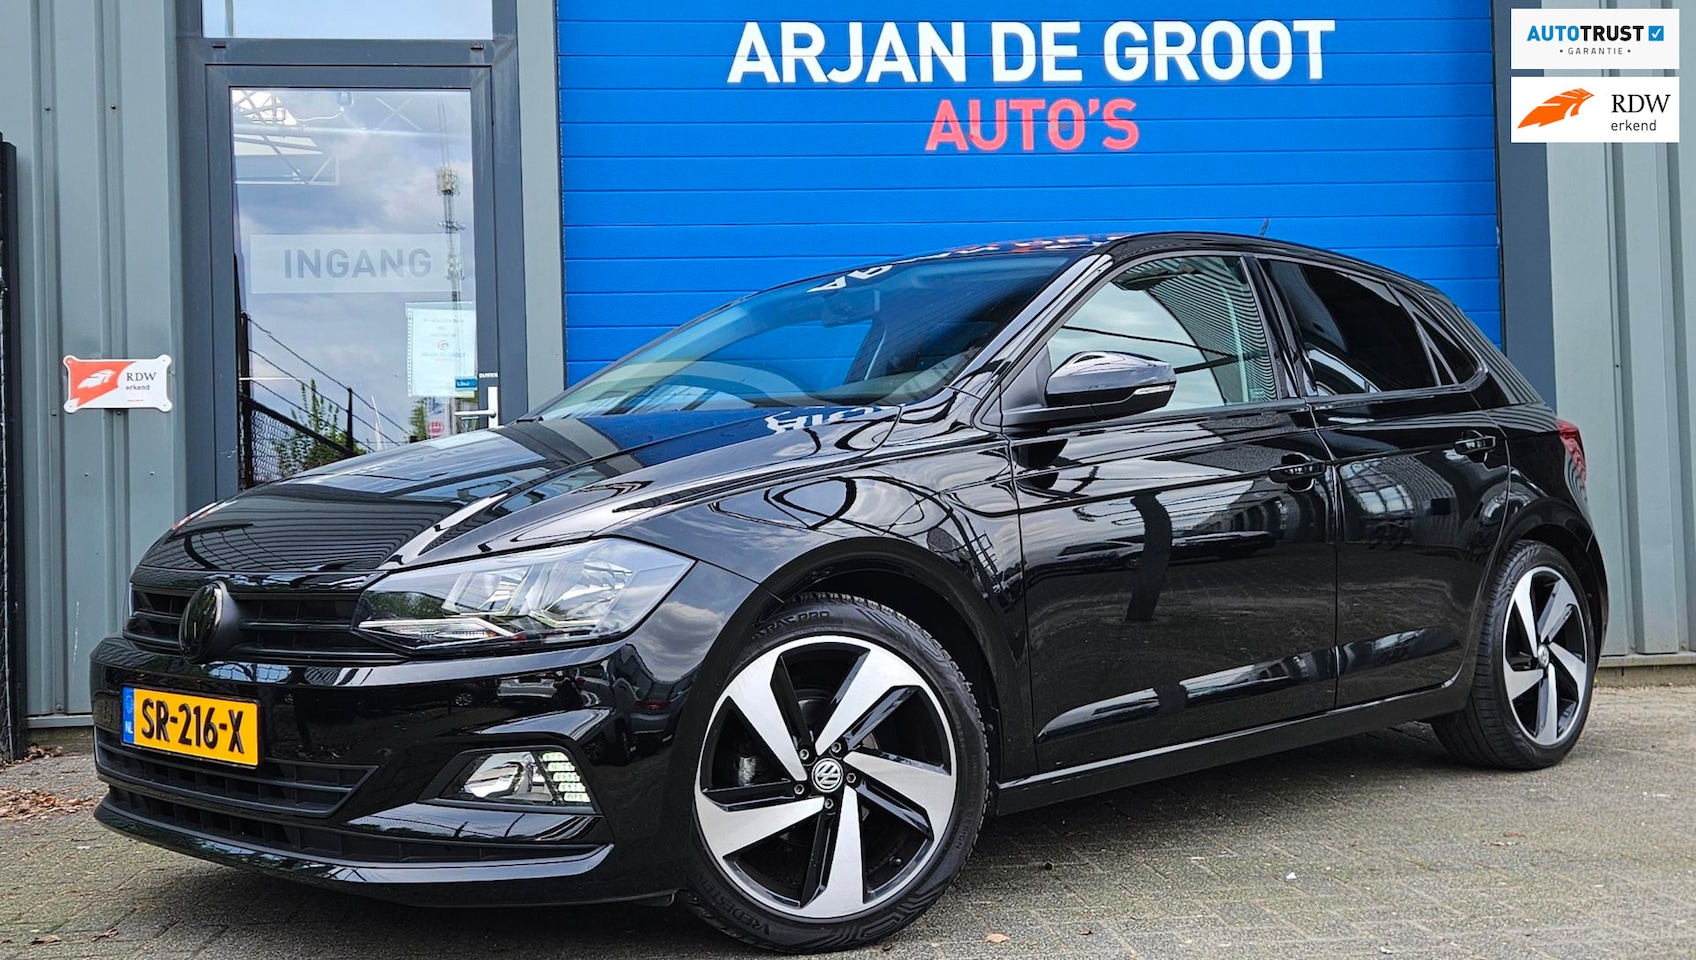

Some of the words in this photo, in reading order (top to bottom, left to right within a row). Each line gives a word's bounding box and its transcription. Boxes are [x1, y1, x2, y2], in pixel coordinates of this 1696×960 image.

[726, 20, 967, 83] ARJAN
[992, 20, 1083, 82] DE
[1103, 19, 1336, 82] GROOT
[925, 98, 1140, 152] AUTO'S
[284, 248, 432, 279] INGANG
[126, 372, 157, 382] RDW
[124, 720, 134, 734] NL
[141, 697, 245, 755] SR-216-X
